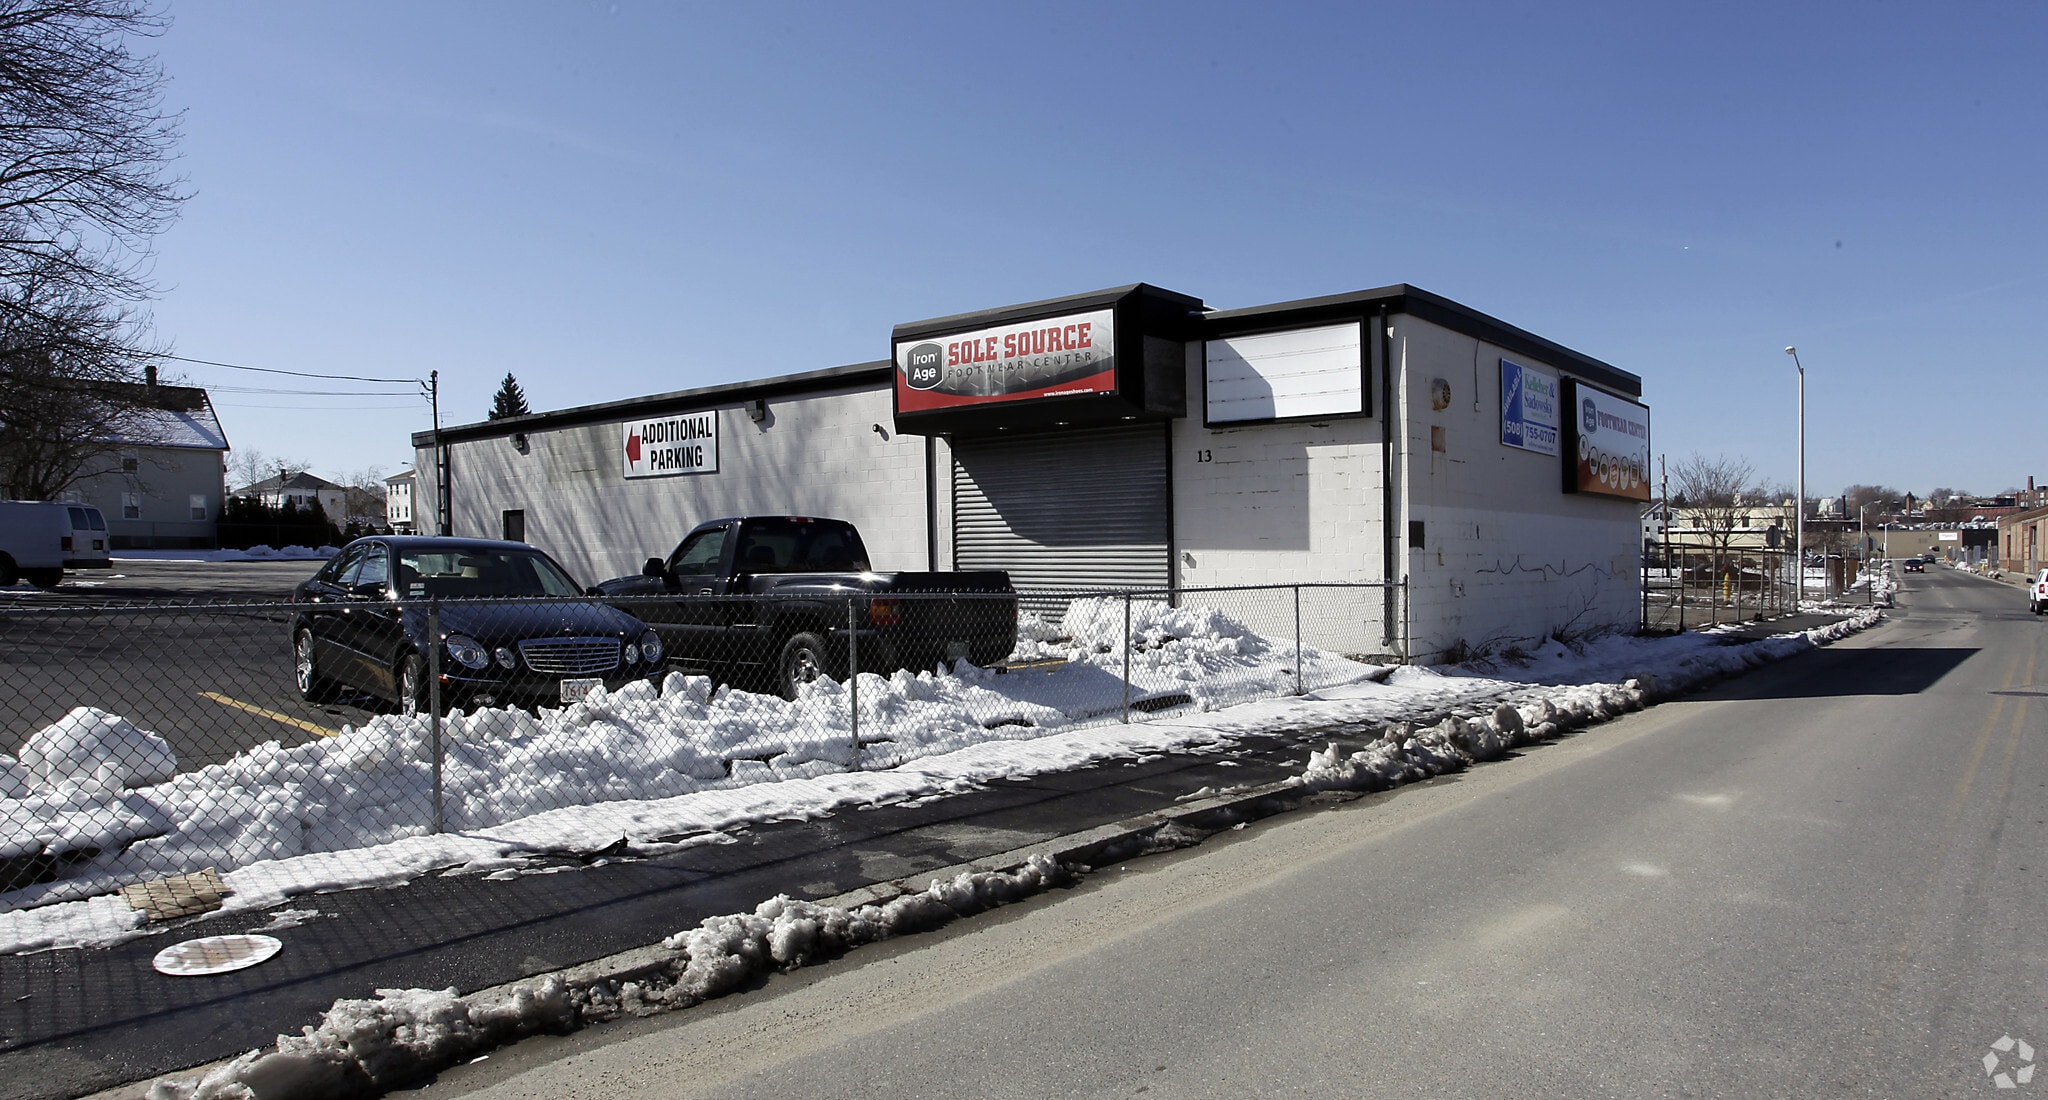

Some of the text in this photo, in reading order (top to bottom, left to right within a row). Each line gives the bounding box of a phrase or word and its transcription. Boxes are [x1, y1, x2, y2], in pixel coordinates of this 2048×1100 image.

[948, 322, 1092, 366] SOLE SOURCE
[913, 353, 936, 365] Iron
[948, 351, 1092, 378] FOOTWEAR CENTER
[913, 367, 937, 381] Age
[1548, 382, 1555, 398] &
[641, 416, 713, 445] ADDITIONAL
[1504, 420, 1556, 444] (508) 755-0707
[1597, 410, 1646, 440] FOOTWEAR CENTER
[650, 445, 703, 471] PARKING
[1197, 449, 1213, 463] 13
